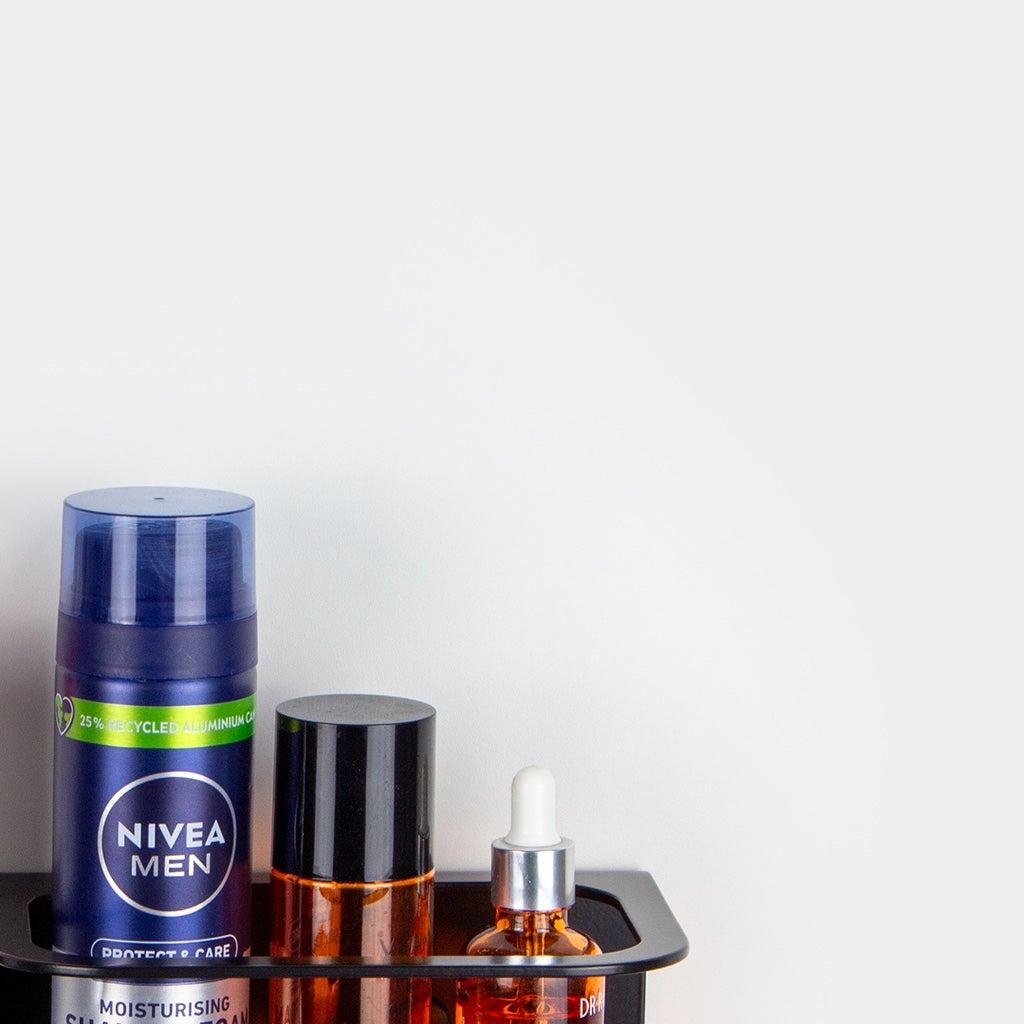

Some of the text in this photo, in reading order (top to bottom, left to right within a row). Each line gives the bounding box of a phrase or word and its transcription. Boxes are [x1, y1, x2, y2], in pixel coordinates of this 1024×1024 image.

[80, 714, 105, 730] 25%
[108, 719, 180, 735] RECYCLED
[182, 713, 245, 734] ALUMINIUM
[117, 819, 226, 849] NIVEA
[131, 853, 211, 877] MEN
[100, 996, 230, 1019] MOISTURISING
